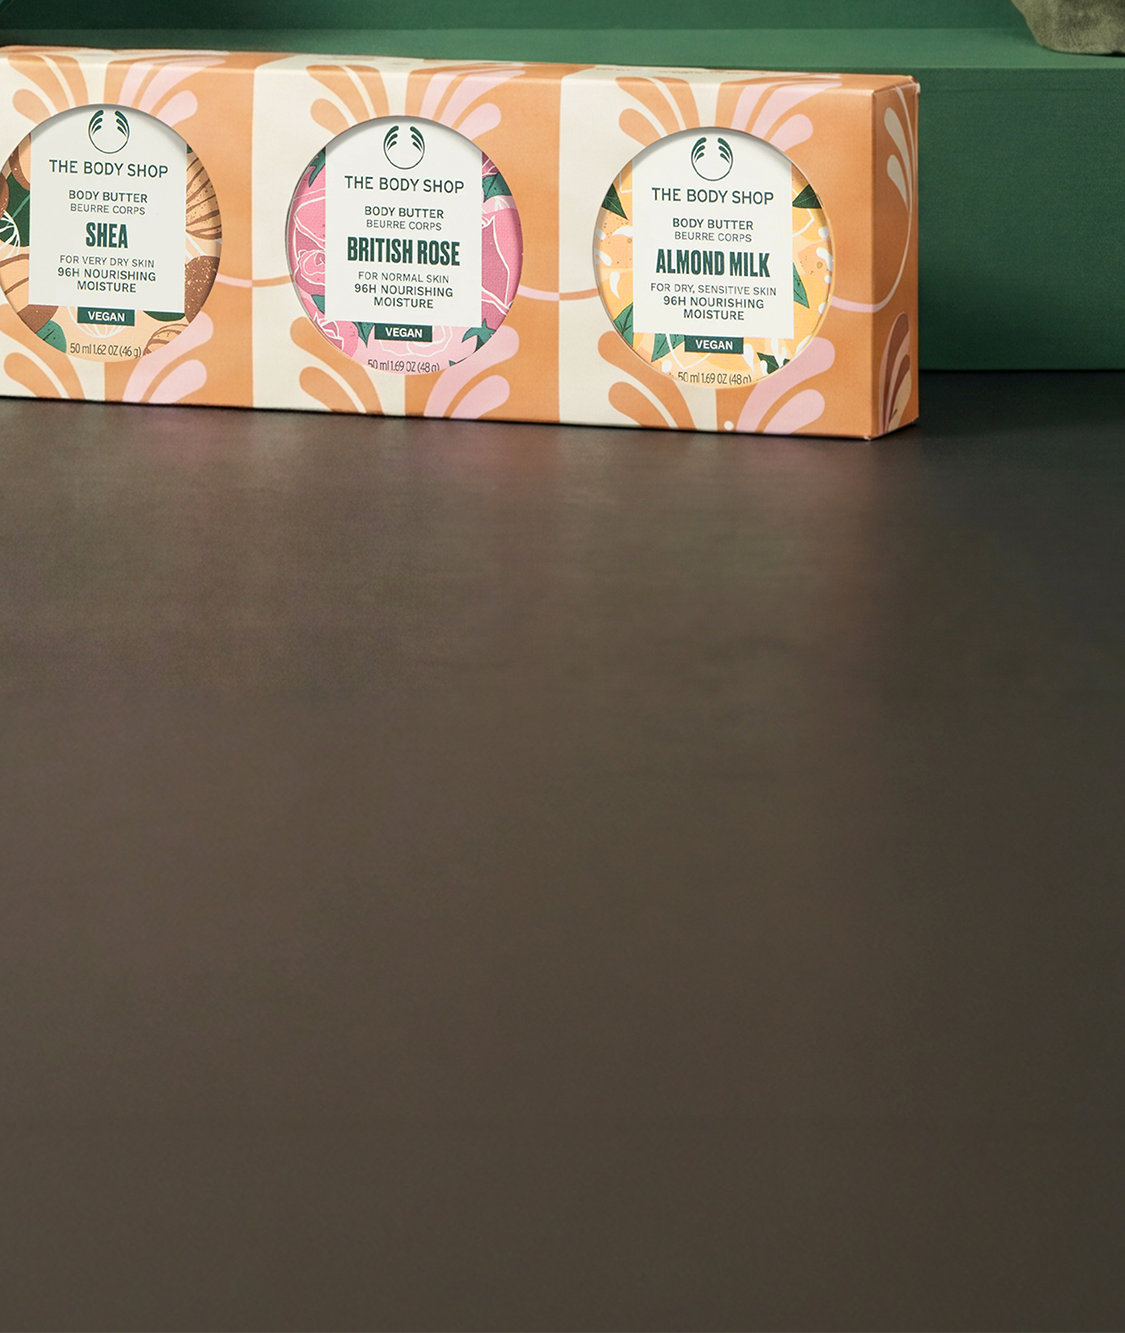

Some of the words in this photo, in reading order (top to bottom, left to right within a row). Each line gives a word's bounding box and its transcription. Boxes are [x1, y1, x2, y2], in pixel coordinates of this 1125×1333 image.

[49, 159, 78, 174] THE
[83, 161, 124, 176] BODY
[127, 163, 168, 179] SHOP
[344, 175, 374, 190] THE
[379, 177, 420, 192] BODY
[423, 179, 465, 194] SHOP
[69, 190, 100, 201] BODY
[102, 192, 148, 203] BUTTER
[652, 187, 681, 202] THE
[686, 189, 728, 204] BODY
[731, 191, 774, 206] SHOP
[364, 206, 396, 217] BODY
[398, 208, 444, 220] BUTTER
[672, 218, 705, 229] BODY
[707, 219, 754, 231] BUTTER
[85, 221, 129, 249] SHEA
[347, 236, 413, 265] BRITISH
[417, 239, 461, 267] ROSE
[655, 248, 725, 276] ALMOND
[729, 251, 771, 278] MILK
[77, 280, 137, 293] MOISTURE
[650, 282, 671, 293] FOR
[674, 284, 696, 295] DRY,
[698, 285, 750, 296] SENSITIVE
[753, 286, 777, 297] SKIN
[87, 311, 125, 322] VEGAN
[385, 327, 423, 338] VEGAN
[695, 339, 733, 350] VEGAN
